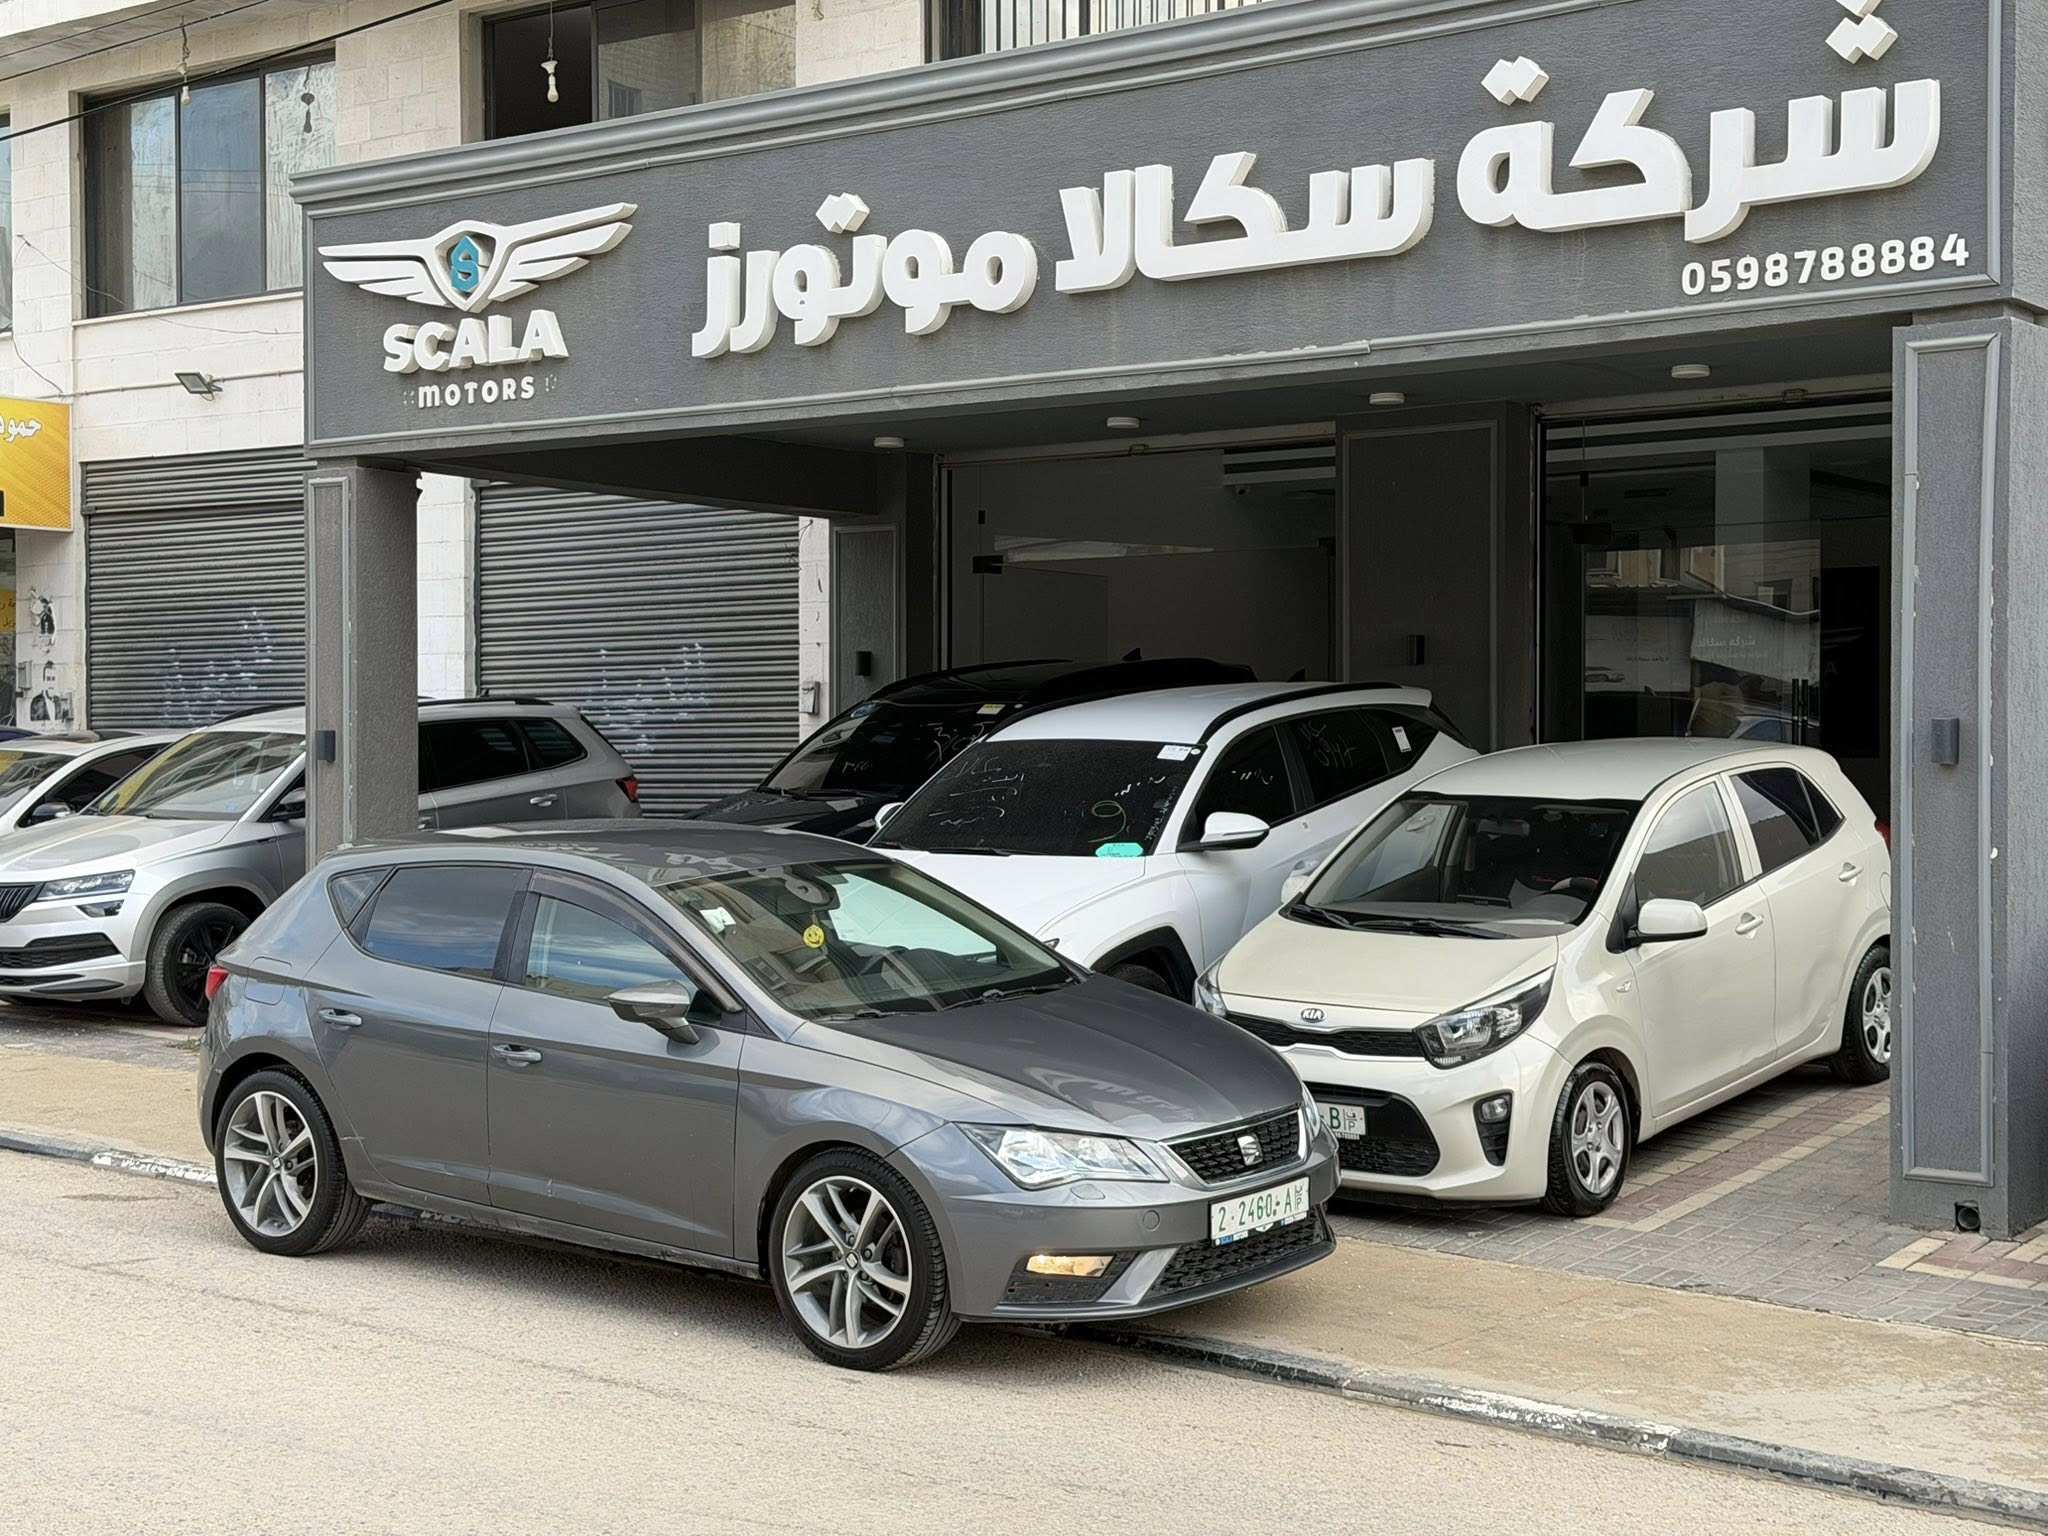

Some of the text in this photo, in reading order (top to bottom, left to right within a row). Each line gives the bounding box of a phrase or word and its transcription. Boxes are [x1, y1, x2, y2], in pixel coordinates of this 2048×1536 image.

[692, 0, 1941, 359] شركة سكالا موتورز
[1681, 233, 1970, 296] 0598788884
[383, 309, 569, 374] SCALA
[418, 376, 535, 409] MOTORS
[1302, 1009, 1323, 1020] KIA
